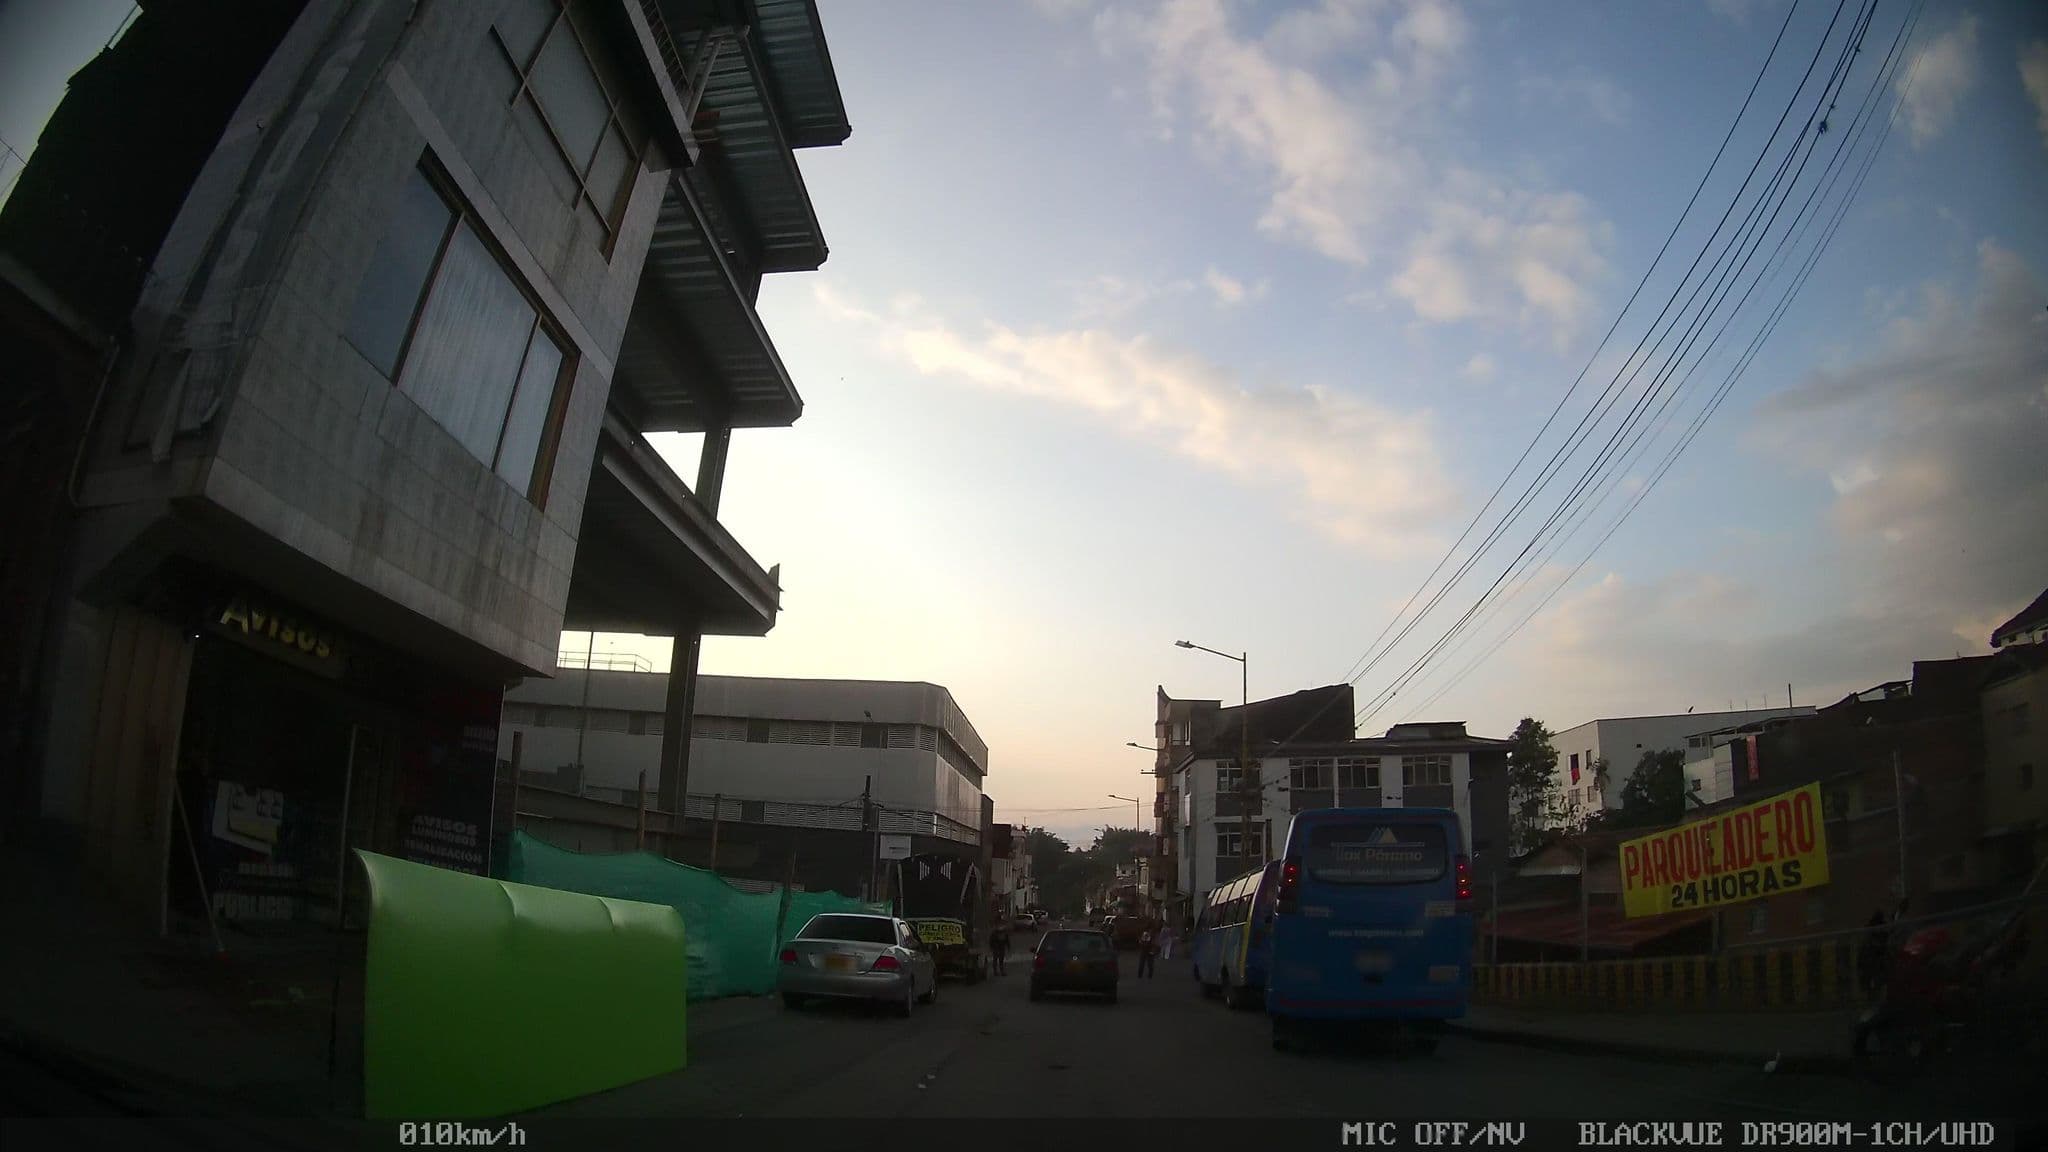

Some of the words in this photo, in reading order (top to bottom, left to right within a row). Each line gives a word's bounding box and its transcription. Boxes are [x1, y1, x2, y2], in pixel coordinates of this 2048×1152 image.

[1623, 791, 1815, 890] PARQUEADERO
[1671, 882, 1698, 908] 24
[1702, 860, 1802, 902] HORAS
[918, 923, 961, 934] PELIGRO
